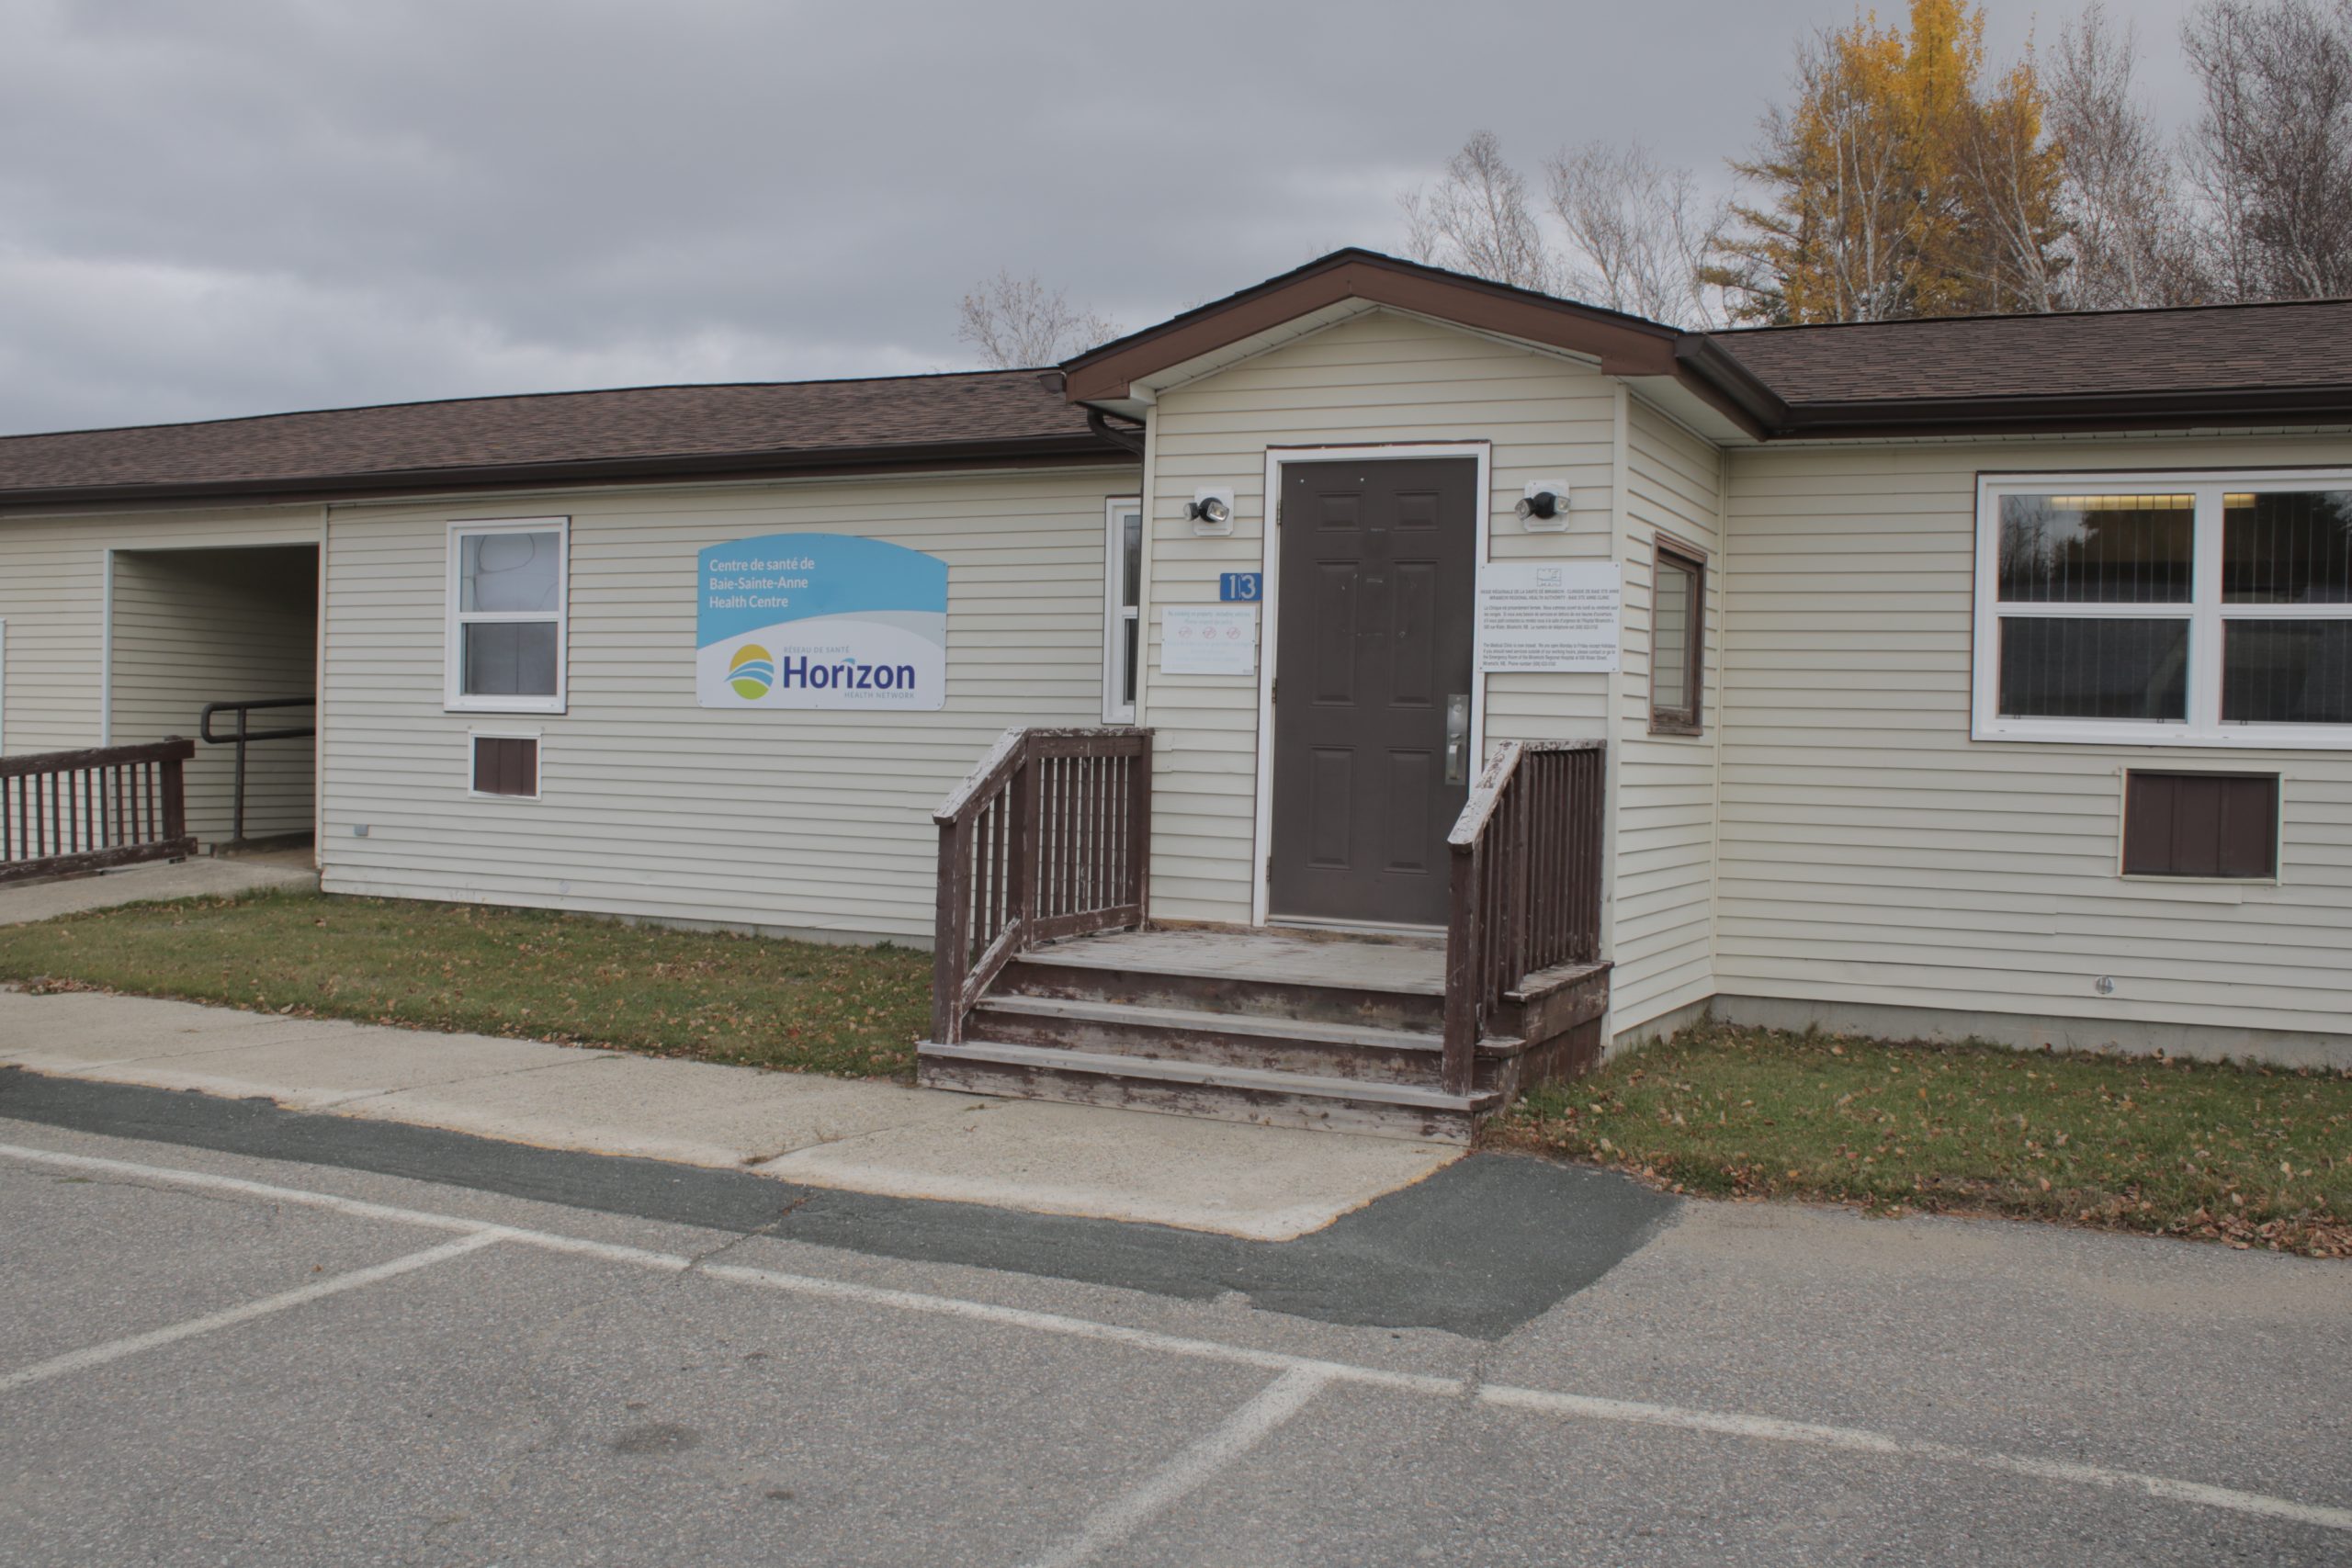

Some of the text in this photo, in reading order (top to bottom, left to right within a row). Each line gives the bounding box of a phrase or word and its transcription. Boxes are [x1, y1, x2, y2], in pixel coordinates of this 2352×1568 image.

[709, 557, 815, 572] Centre de santé de
[709, 577, 808, 591] Baie-Sainte-Anne
[1229, 574, 1256, 599] 13
[709, 595, 788, 609] Health Centre
[784, 645, 812, 654] RÉSEAU
[825, 645, 851, 653] SANTÉ
[784, 656, 915, 689] Horizon
